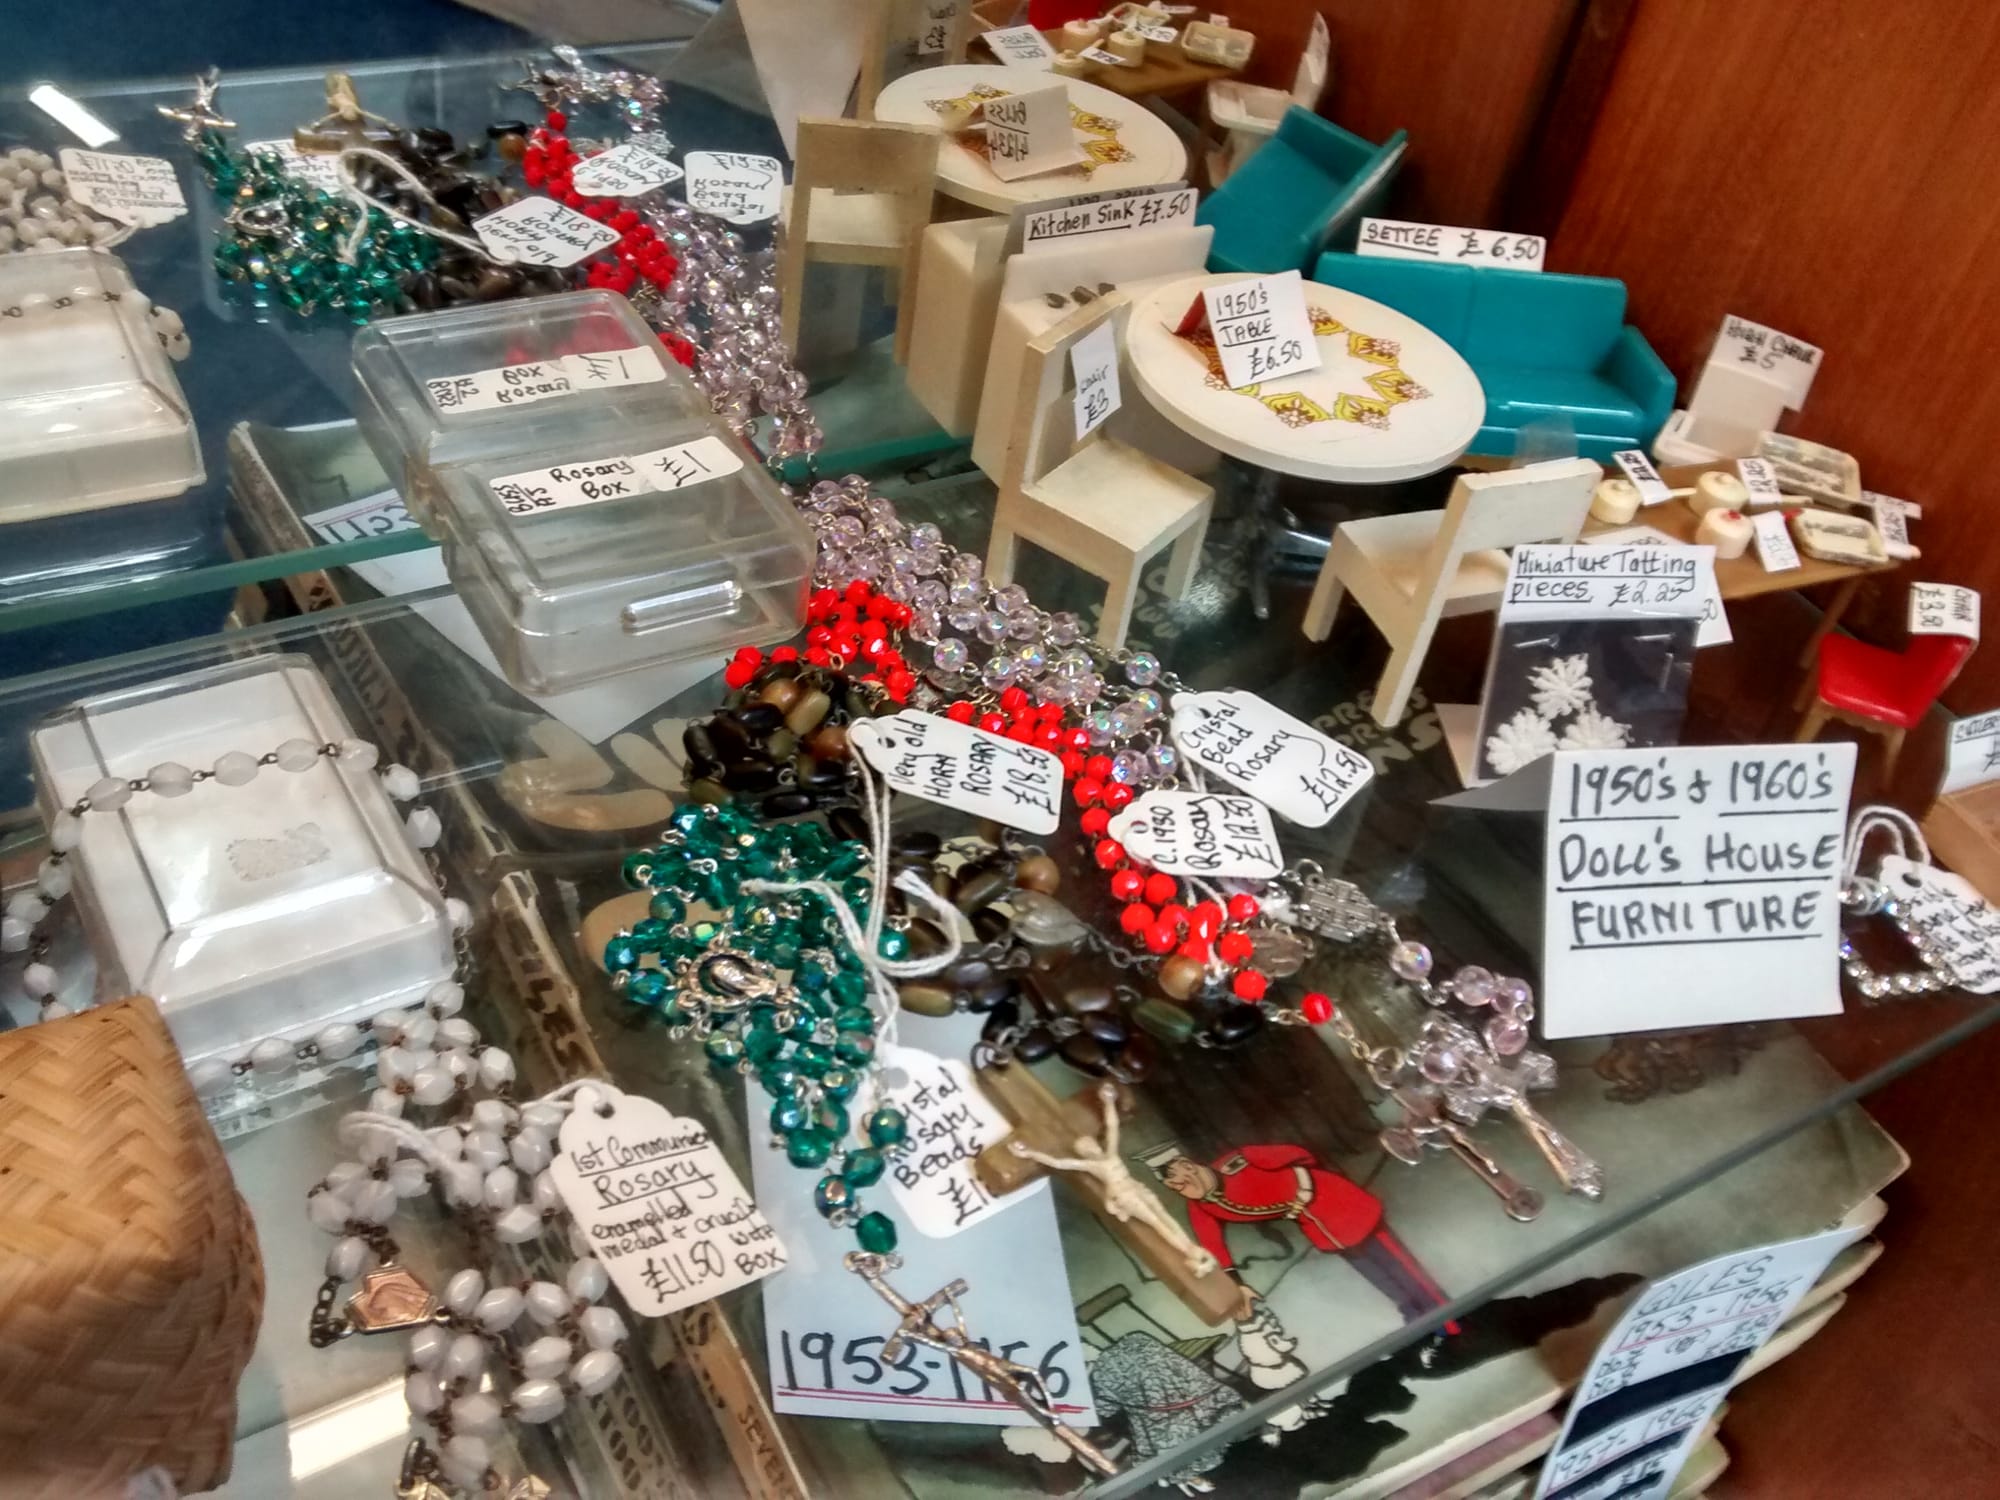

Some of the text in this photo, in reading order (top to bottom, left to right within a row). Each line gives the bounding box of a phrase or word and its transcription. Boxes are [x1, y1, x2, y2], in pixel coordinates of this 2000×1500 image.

[1029, 211, 1092, 238] Kitchen
[1139, 194, 1191, 227] £7.50
[1366, 223, 1442, 247] SETTEE
[1215, 282, 1269, 316] 1950's
[1219, 318, 1274, 346] TABLE
[1249, 341, 1303, 380] £6.50
[550, 459, 635, 484] Rosary
[581, 481, 631, 500] Box
[655, 449, 712, 487] £1
[1515, 547, 1696, 587] Miniature Tatting
[1608, 579, 1688, 607] £2.25
[1181, 699, 1240, 749] Crystal
[1202, 722, 1253, 765] Bead
[889, 717, 928, 786] Very old
[960, 733, 1003, 797] ROSARY
[1225, 729, 1296, 781] Rosary
[923, 753, 957, 800] HORN
[1002, 747, 1057, 816] £18.50
[1300, 750, 1368, 814] £12.50
[1570, 757, 1677, 818] 1950's
[1730, 753, 1833, 804] 1960's
[1185, 796, 1226, 871] Rosary
[1224, 799, 1280, 869] £12.50
[1570, 890, 1822, 945] FURNITURE
[570, 1140, 605, 1173] 1st
[893, 1136, 984, 1191] Beads
[593, 1158, 718, 1206] Rosary
[640, 1239, 726, 1303] £11.50
[1638, 1255, 1775, 1317] GILES
